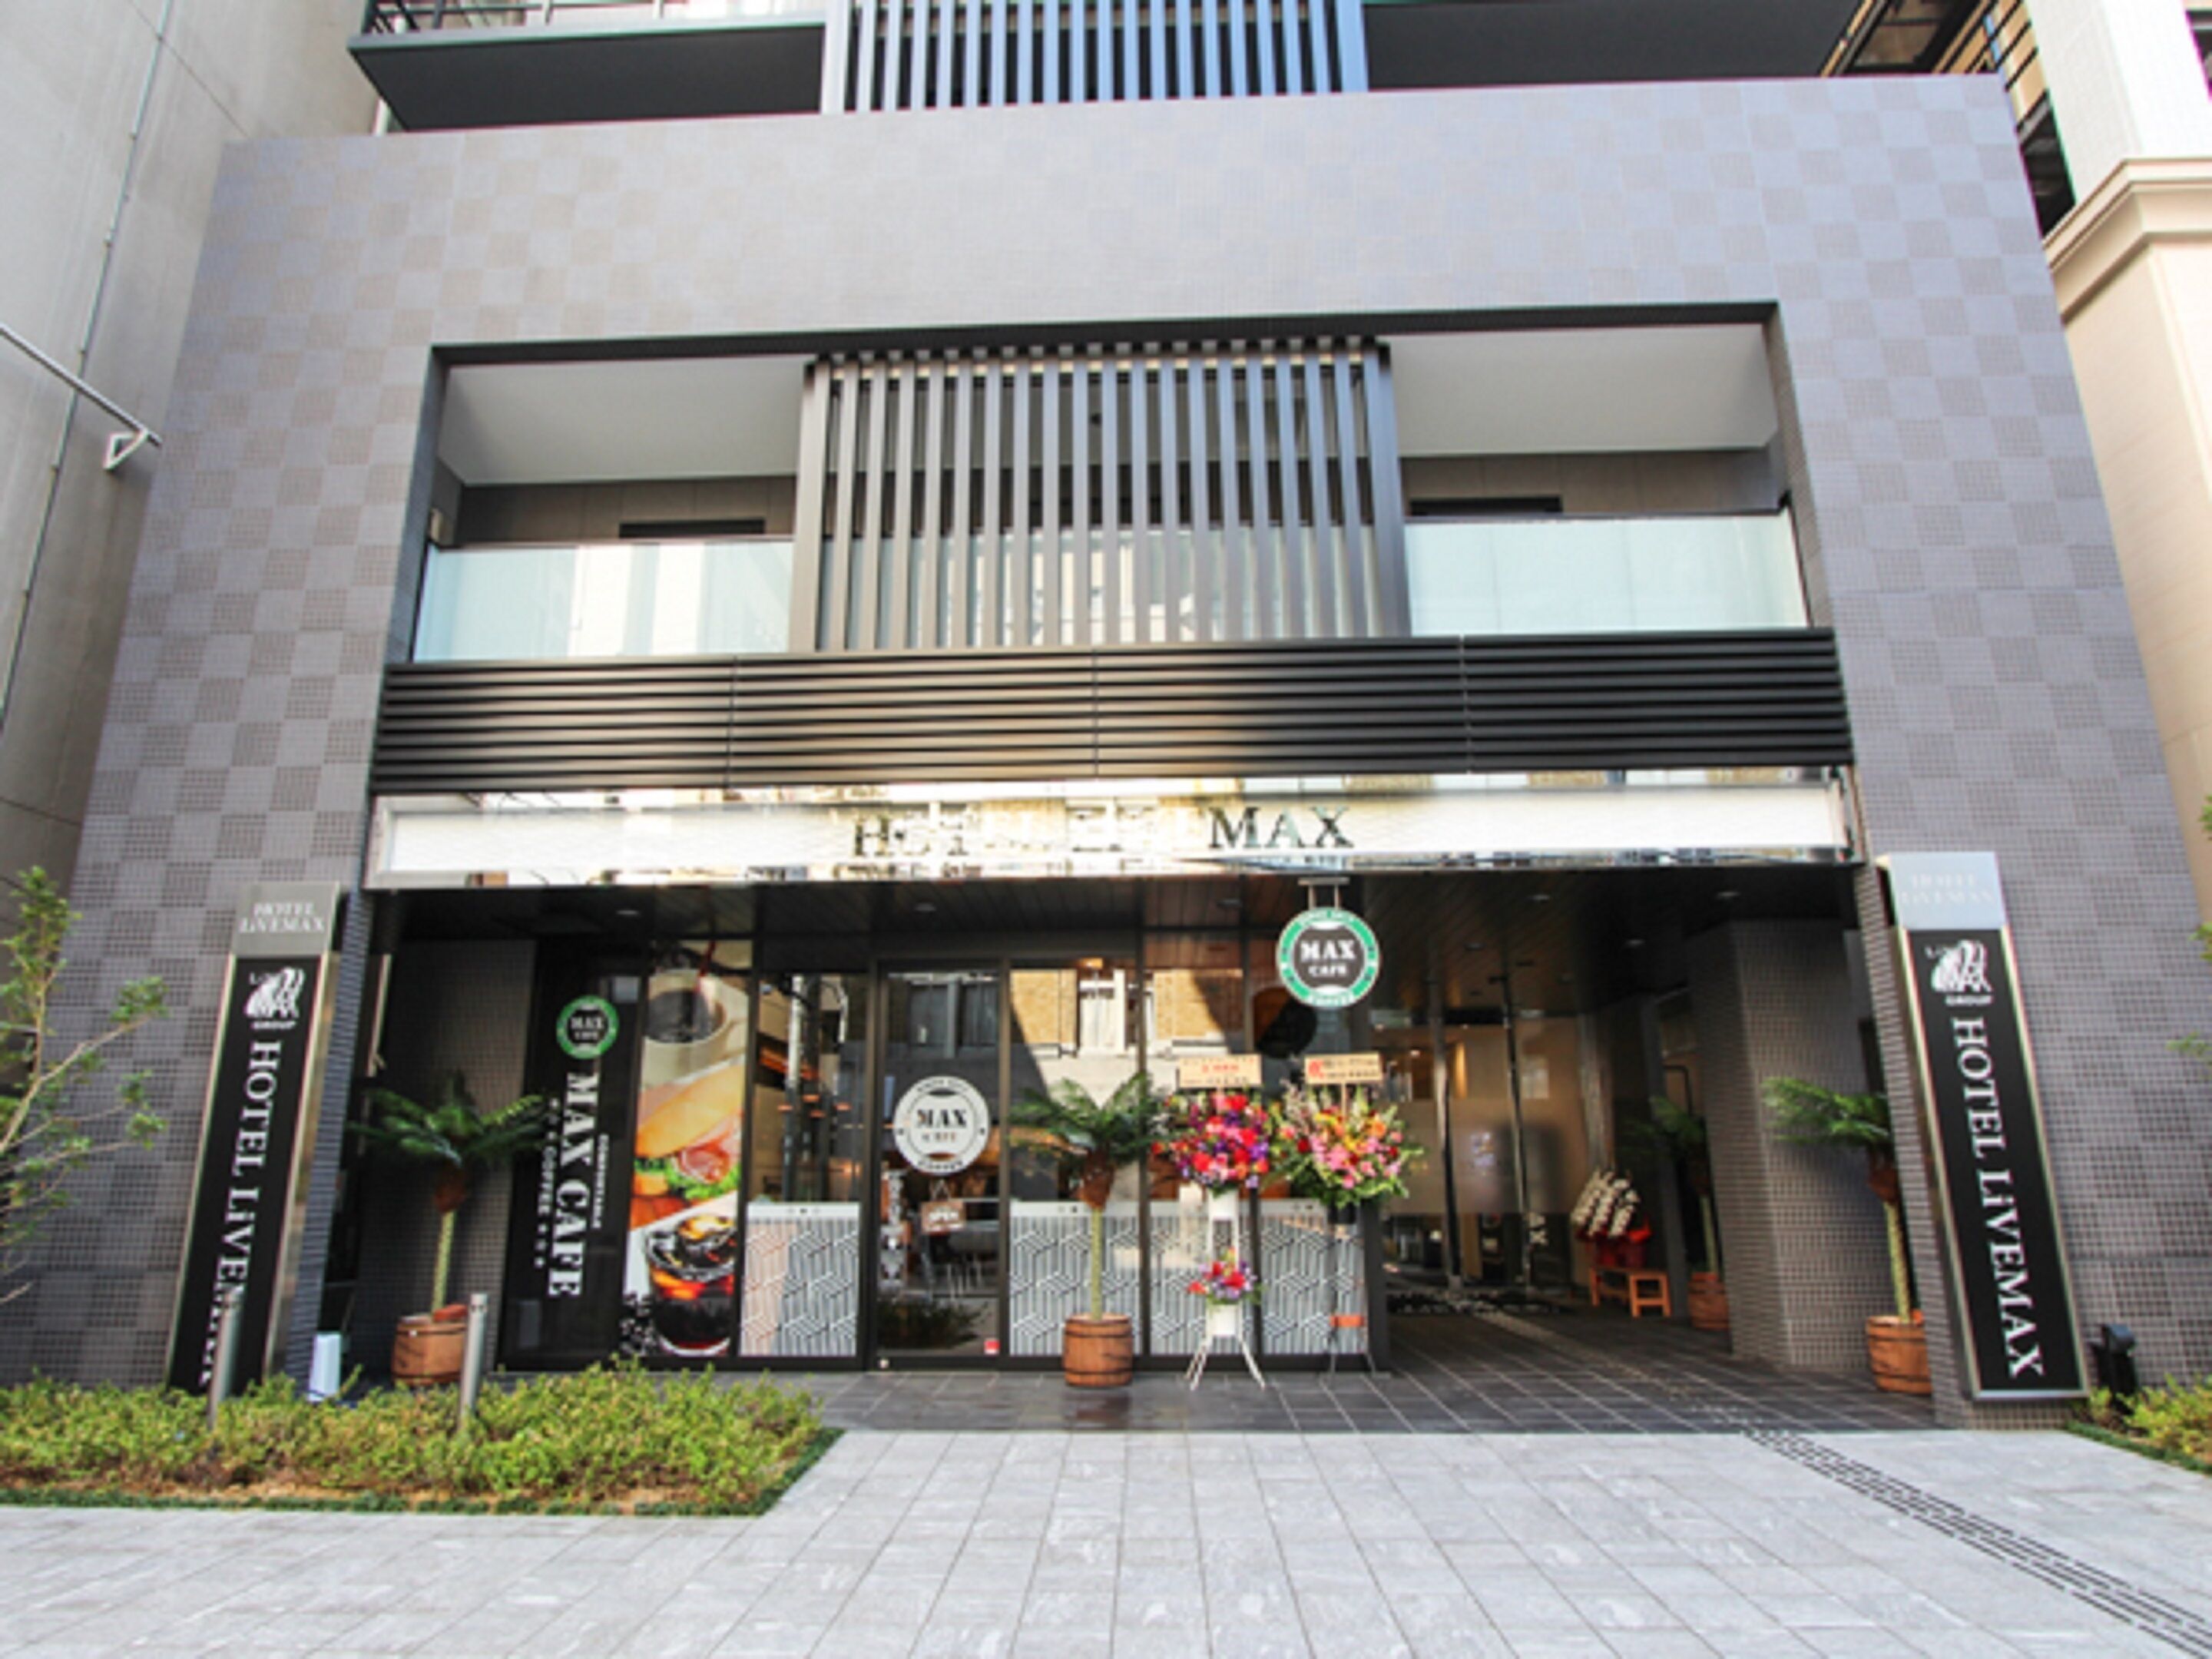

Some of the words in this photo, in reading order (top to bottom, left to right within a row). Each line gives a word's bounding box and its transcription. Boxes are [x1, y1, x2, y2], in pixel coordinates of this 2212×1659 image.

[1300, 940, 1356, 962] MAX
[232, 1041, 283, 1177] HOTEL
[561, 1072, 599, 1166] MAX
[916, 1108, 967, 1128] MAX
[1952, 1018, 2007, 1158] HOTEL
[548, 1180, 590, 1296] CAFE
